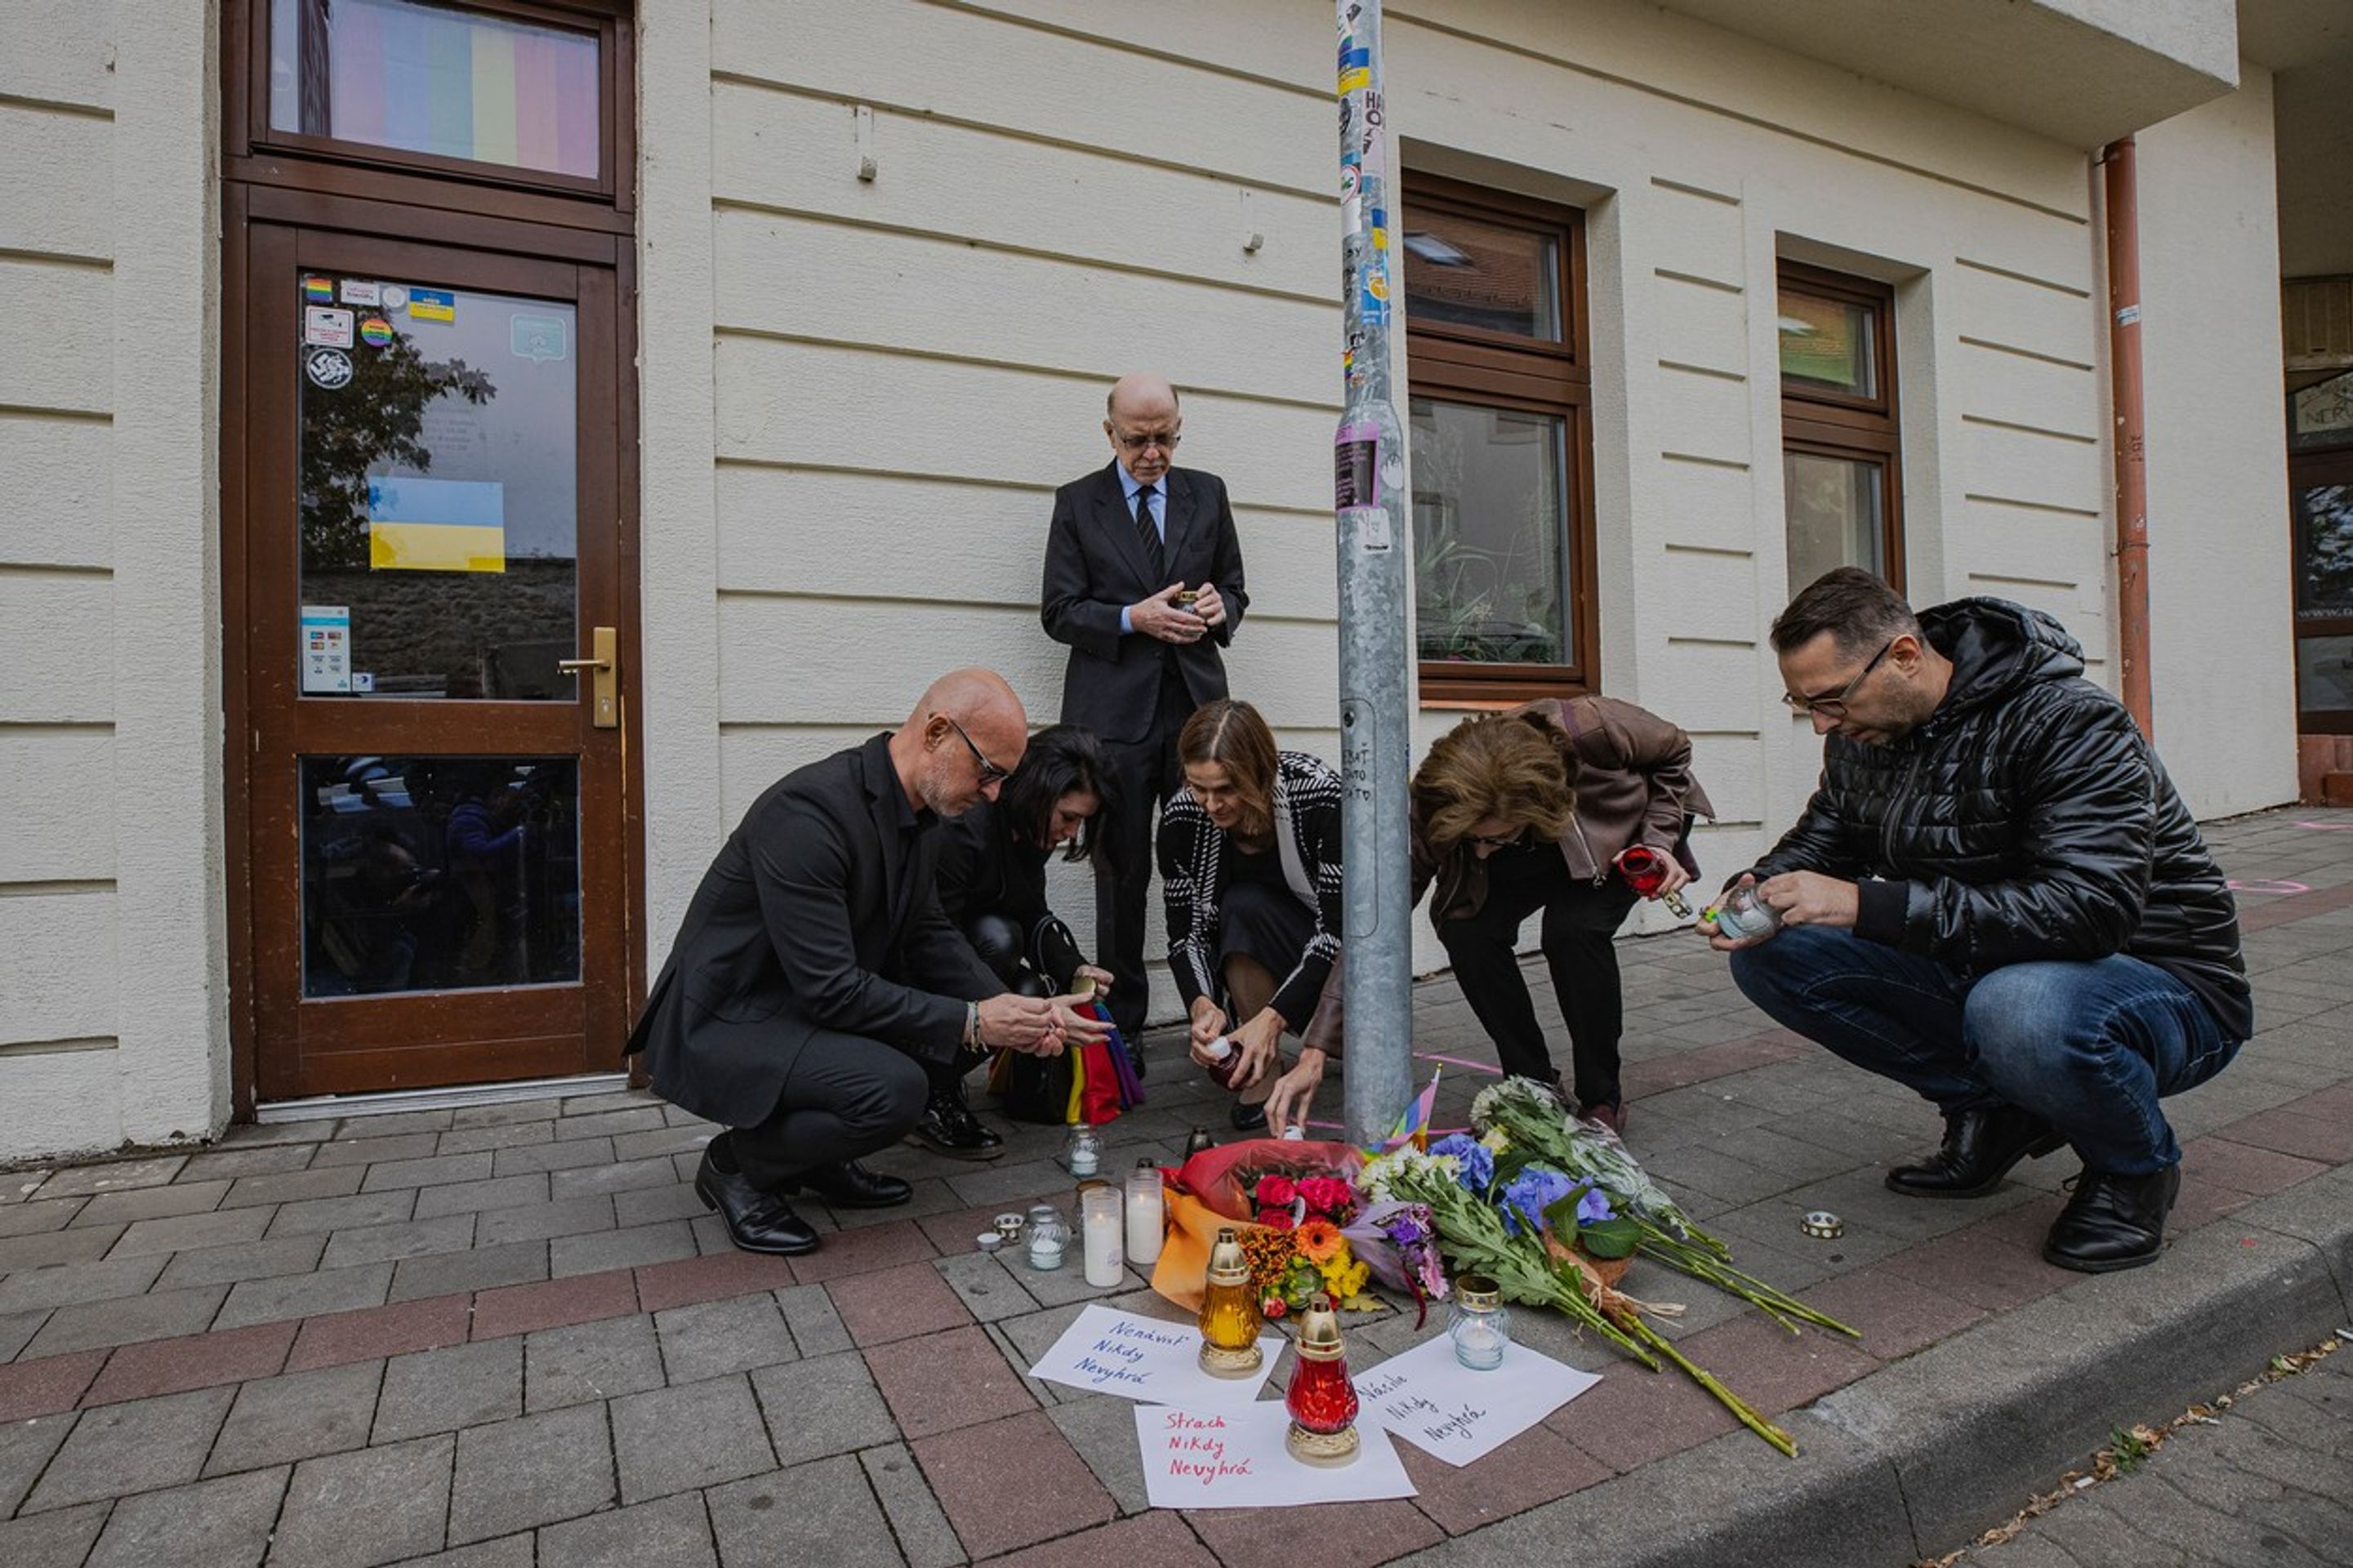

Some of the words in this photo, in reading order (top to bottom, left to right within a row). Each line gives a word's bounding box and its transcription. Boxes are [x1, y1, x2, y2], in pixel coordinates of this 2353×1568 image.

[1073, 1356, 1152, 1384] Nevyhrá
[1165, 1411, 1226, 1429] Strach
[1423, 1404, 1486, 1441] Nevyhrá
[1170, 1459, 1253, 1486] Nevyhrá
